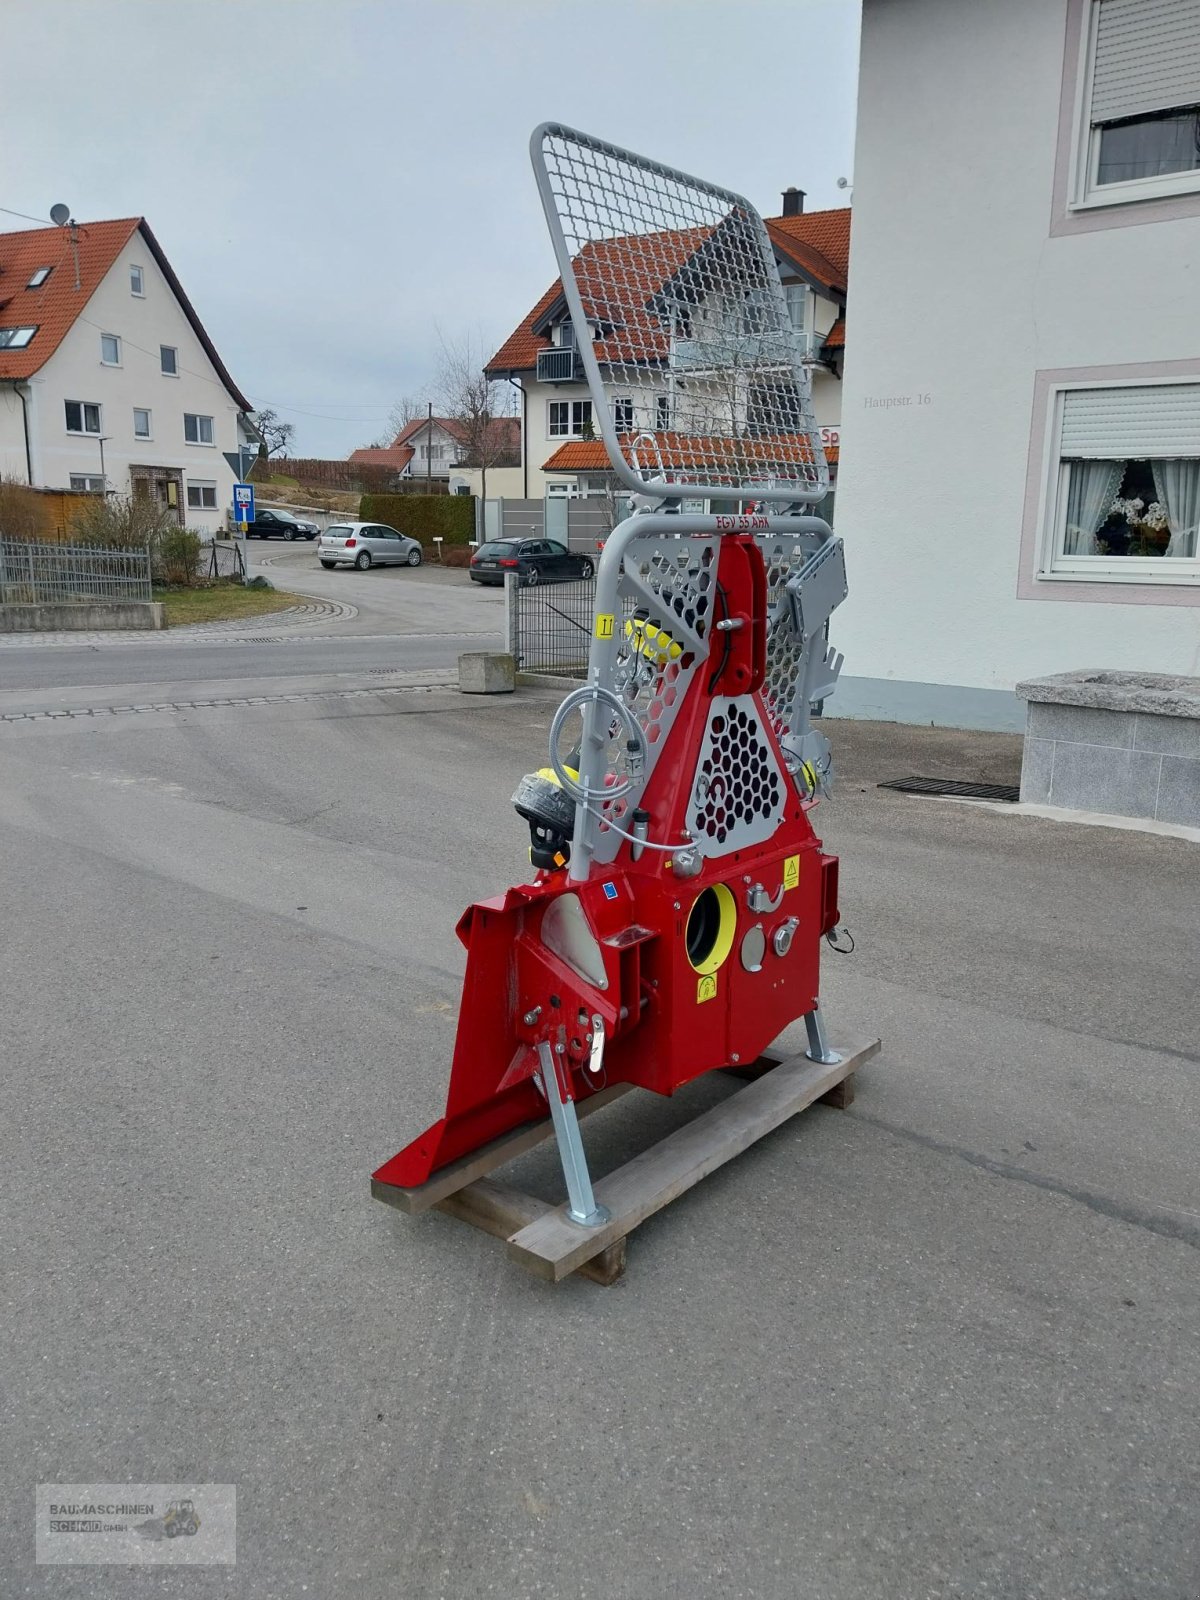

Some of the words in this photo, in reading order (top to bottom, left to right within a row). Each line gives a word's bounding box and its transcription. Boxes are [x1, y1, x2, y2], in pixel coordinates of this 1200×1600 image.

[864, 396, 913, 410] Hauptstr.
[917, 392, 932, 405] 16
[715, 516, 736, 529] EGV
[738, 516, 750, 529] 55
